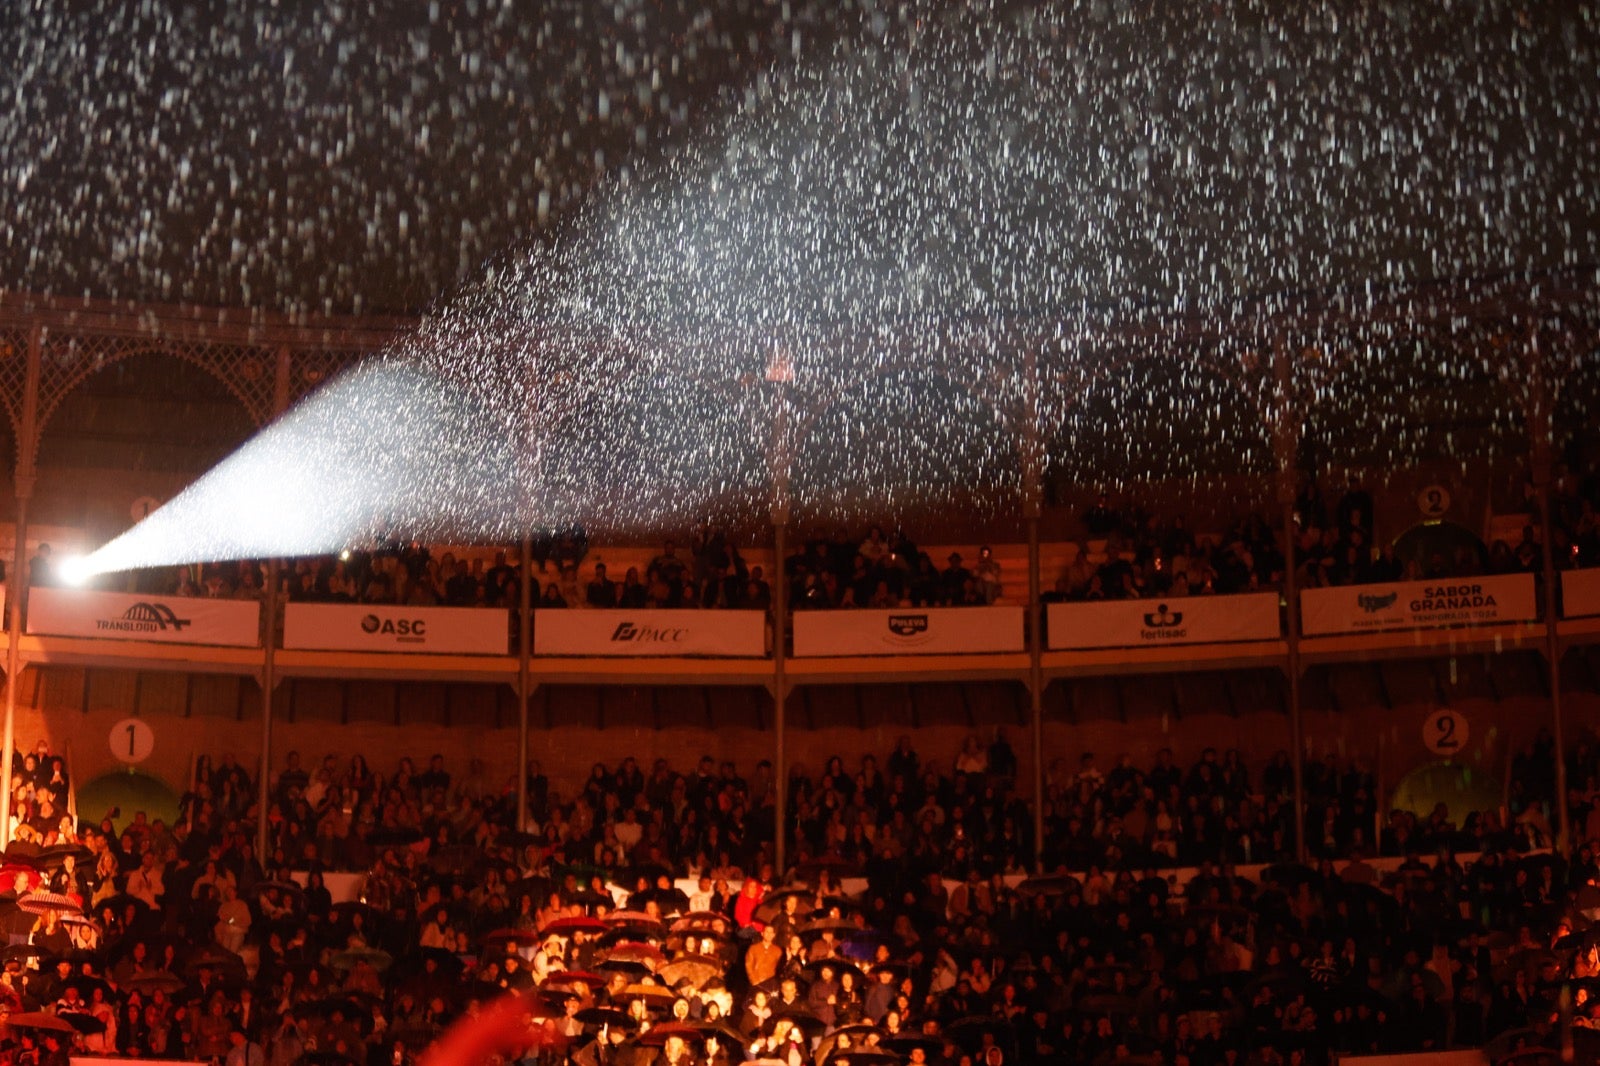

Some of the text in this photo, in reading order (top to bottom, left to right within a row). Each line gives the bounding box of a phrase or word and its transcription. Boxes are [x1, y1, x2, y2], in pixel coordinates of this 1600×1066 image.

[1428, 491, 1442, 513] 2
[1425, 585, 1482, 598] SABOR
[1410, 595, 1497, 612] GRANADA
[1413, 613, 1470, 622] TEMPORADA
[126, 725, 136, 756] 1
[1437, 716, 1459, 748] 2
